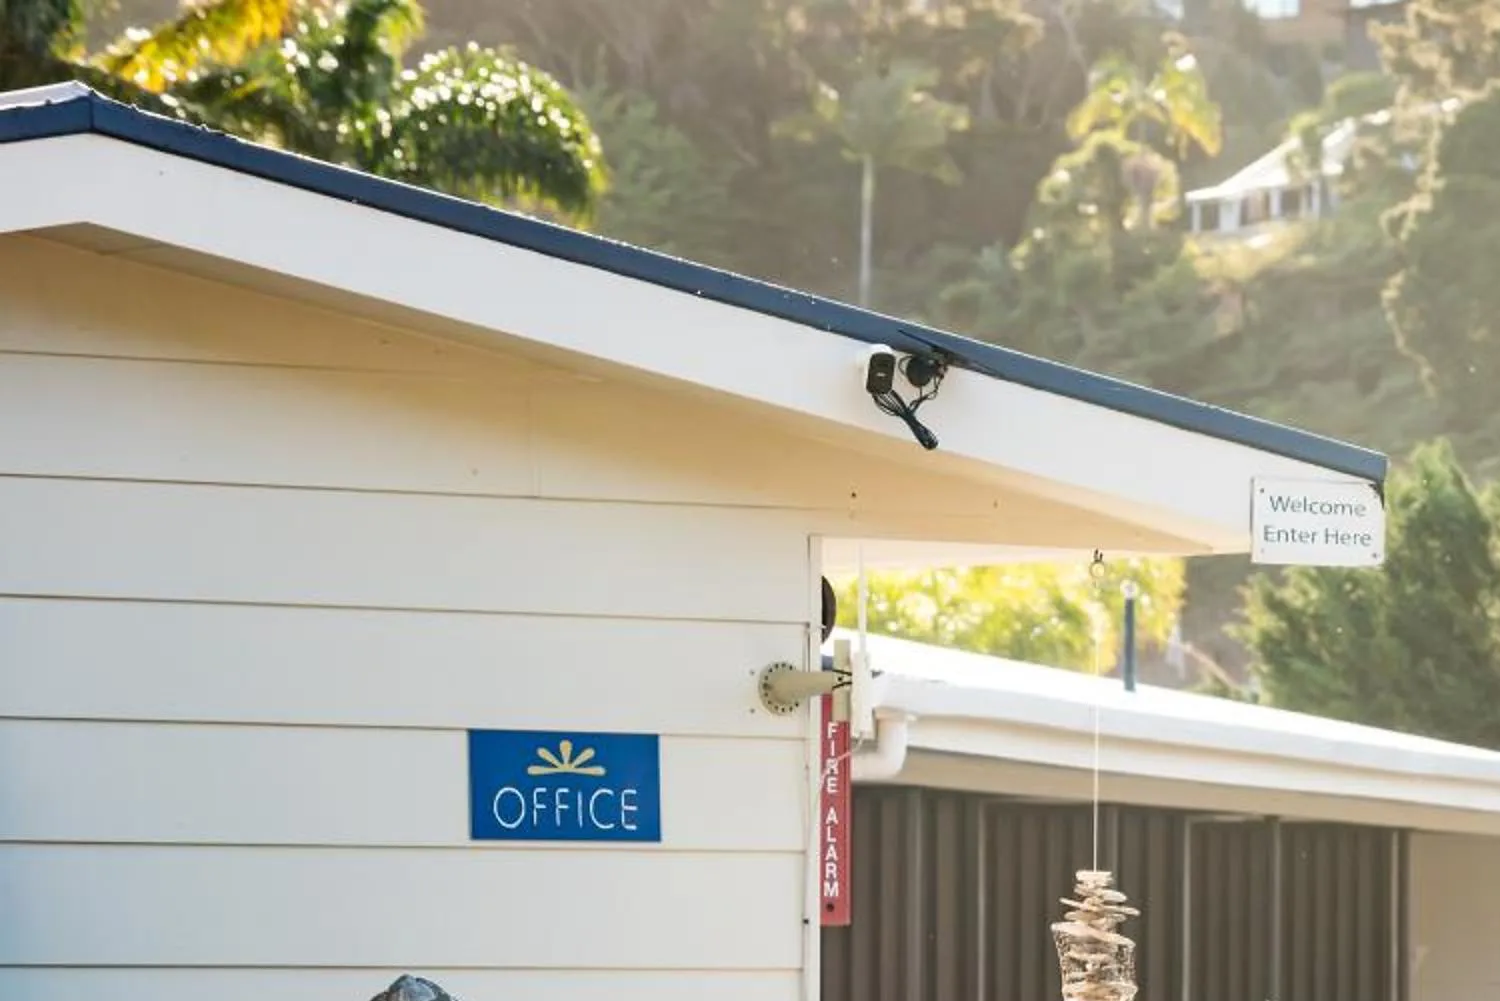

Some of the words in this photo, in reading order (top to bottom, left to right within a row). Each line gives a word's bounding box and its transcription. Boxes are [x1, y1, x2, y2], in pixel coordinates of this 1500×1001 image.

[1269, 495, 1367, 517] Welcome
[1263, 525, 1317, 544] Enter
[1324, 528, 1372, 547] Here
[826, 722, 840, 794] FIRE
[493, 786, 638, 830] OFFICE
[823, 806, 840, 898] ALARM
